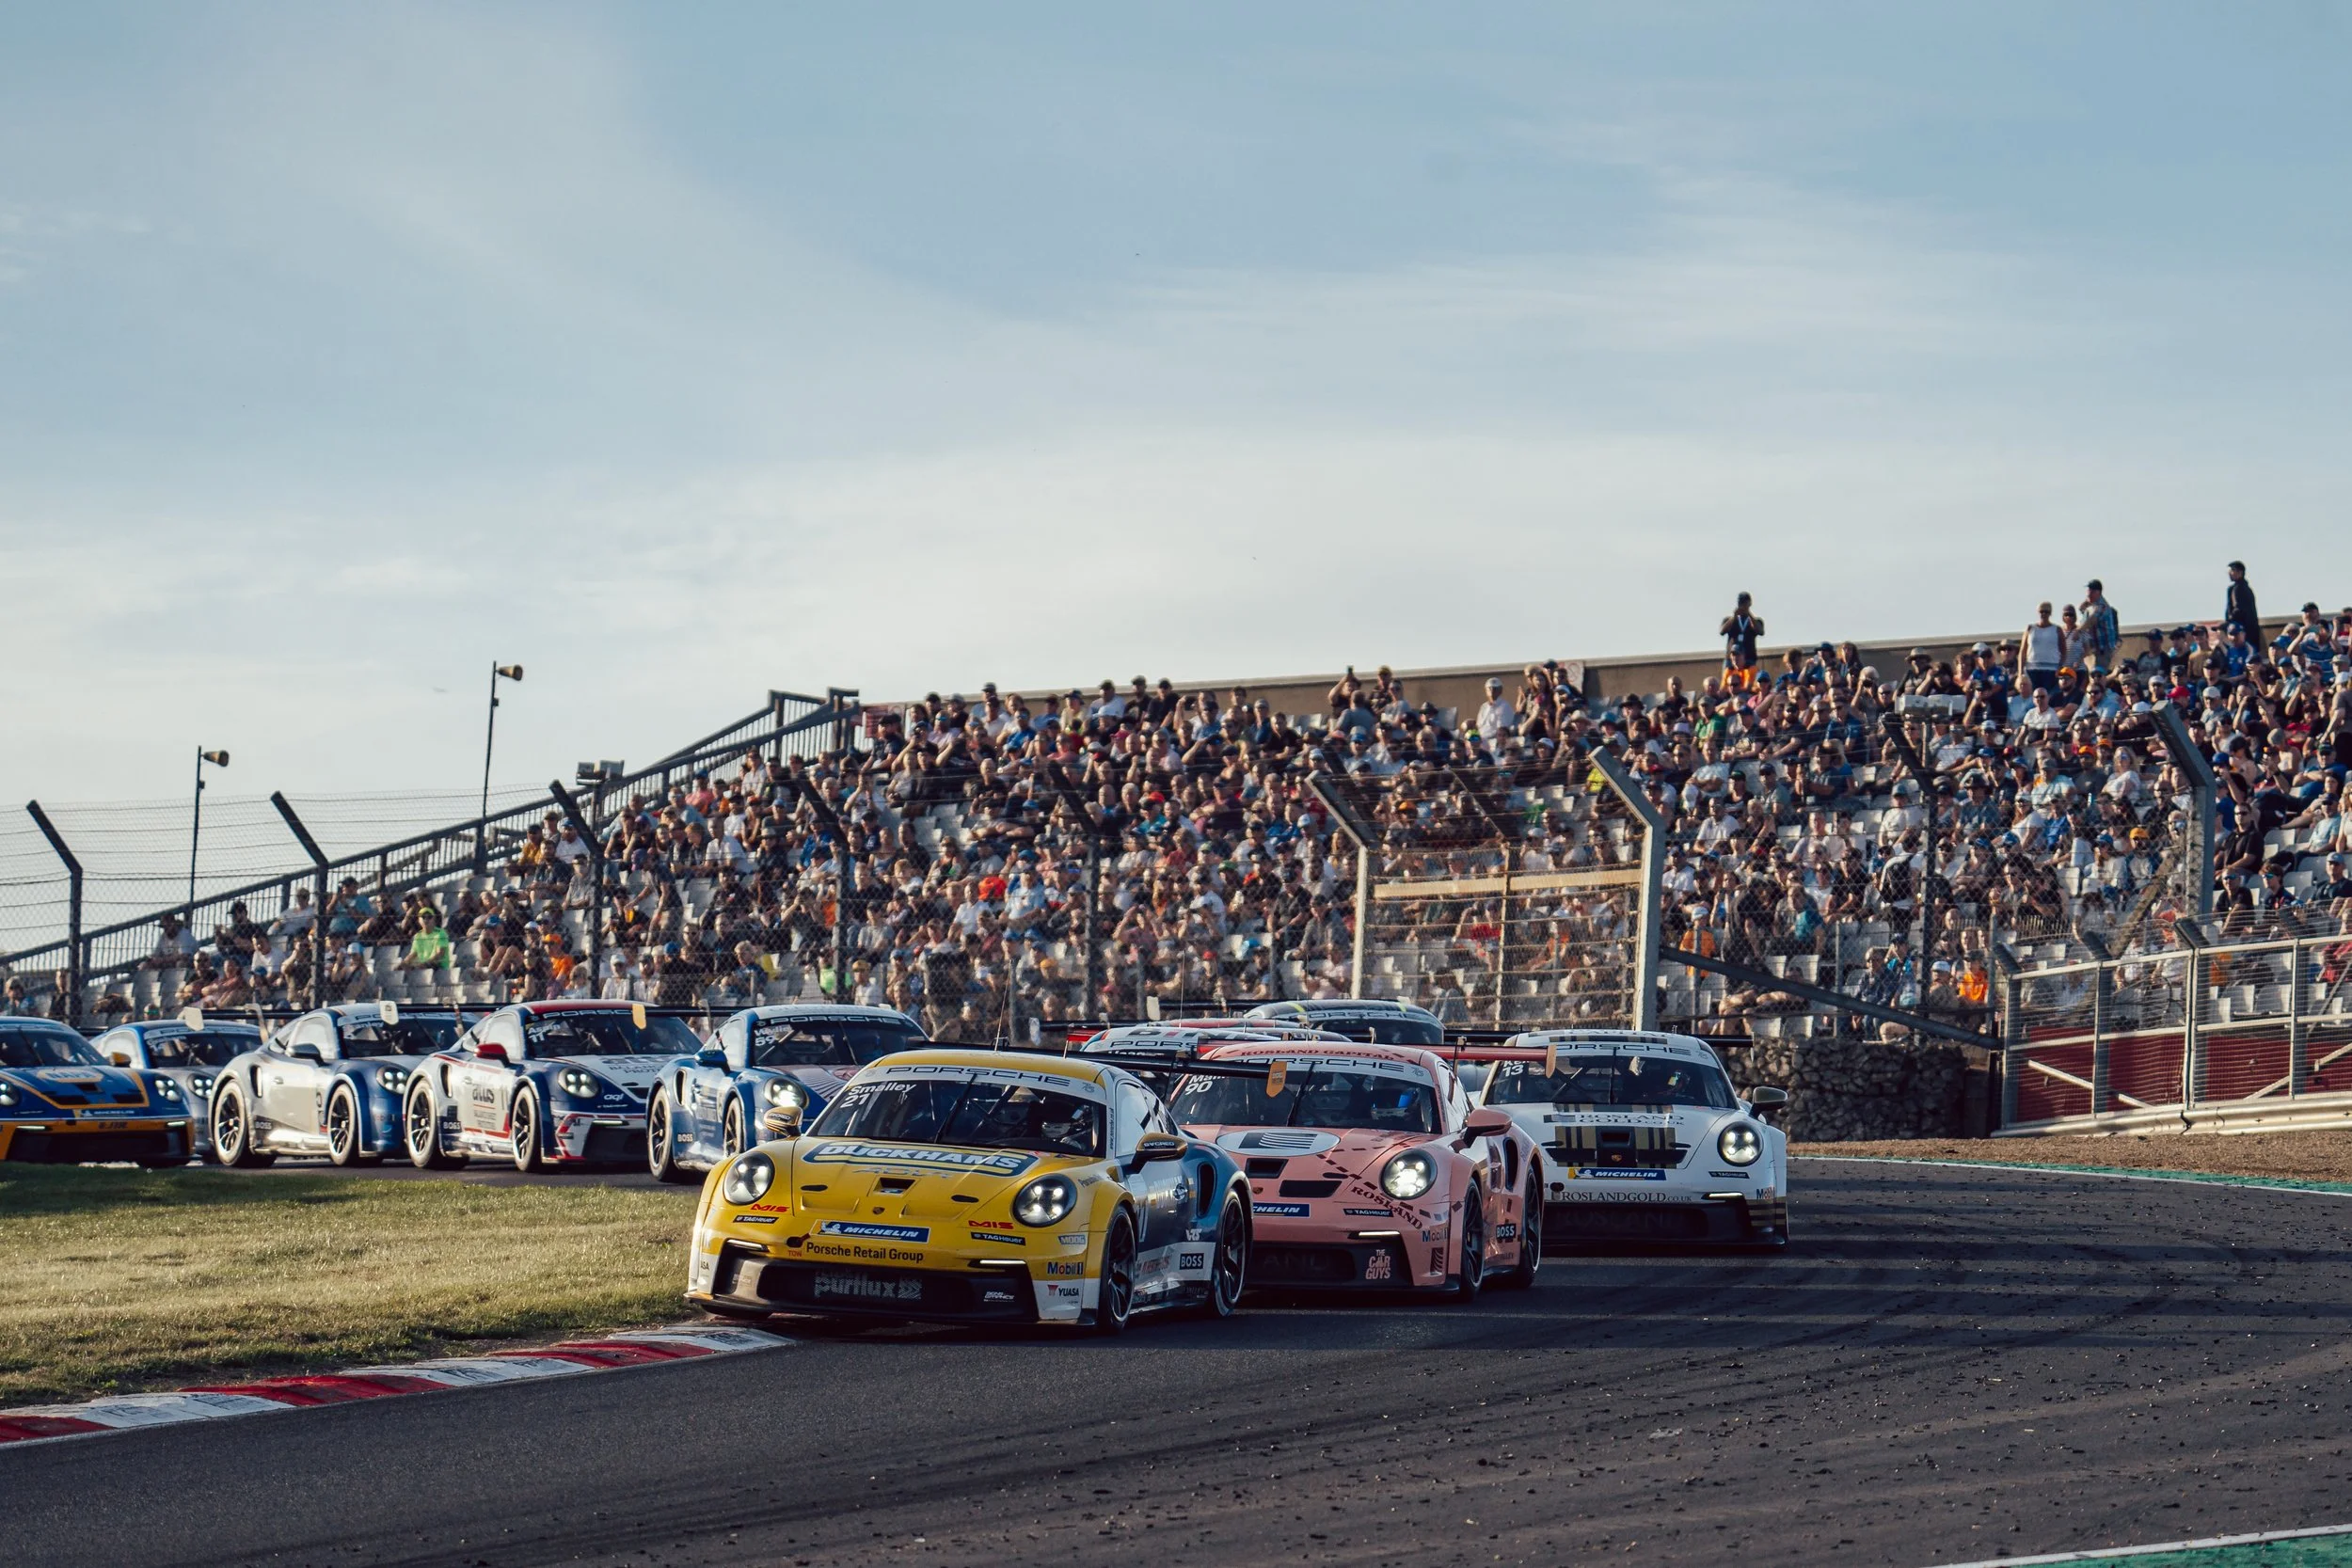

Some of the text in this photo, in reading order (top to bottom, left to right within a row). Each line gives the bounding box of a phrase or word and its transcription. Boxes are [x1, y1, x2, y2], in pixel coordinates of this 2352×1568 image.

[543, 1009, 633, 1019] PORSC
[771, 1016, 901, 1024] PORSCHE
[755, 1036, 776, 1046] 59
[1556, 1043, 1692, 1055] ORSCHE
[886, 1066, 1071, 1086] PORSCHE
[1502, 1064, 1524, 1077] 13
[848, 1082, 917, 1097] Smalley
[1184, 1080, 1214, 1096] 90
[839, 1092, 869, 1109] 21
[442, 1121, 461, 1130] BOSS
[676, 1133, 693, 1143] BOSS
[817, 1144, 1022, 1168] DUCKHAMS
[750, 1203, 790, 1212] MIS
[1253, 1205, 1300, 1213] CHELIN
[1351, 1186, 1423, 1229] ROSLAND
[968, 1220, 1014, 1229] MIS
[843, 1226, 919, 1238] MICHELIN
[1496, 1226, 1515, 1237] BOSS
[982, 1233, 1023, 1243] TAGHeuer
[1060, 1236, 1086, 1244] MOOG
[787, 1249, 803, 1258] TOW
[806, 1243, 924, 1264] Porsche Retail Group
[1181, 1255, 1202, 1267] BOSS
[1369, 1256, 1391, 1268] CAR
[1365, 1268, 1391, 1280] GUYS
[815, 1273, 897, 1298] purflux
[1058, 1287, 1080, 1297] YUASA
